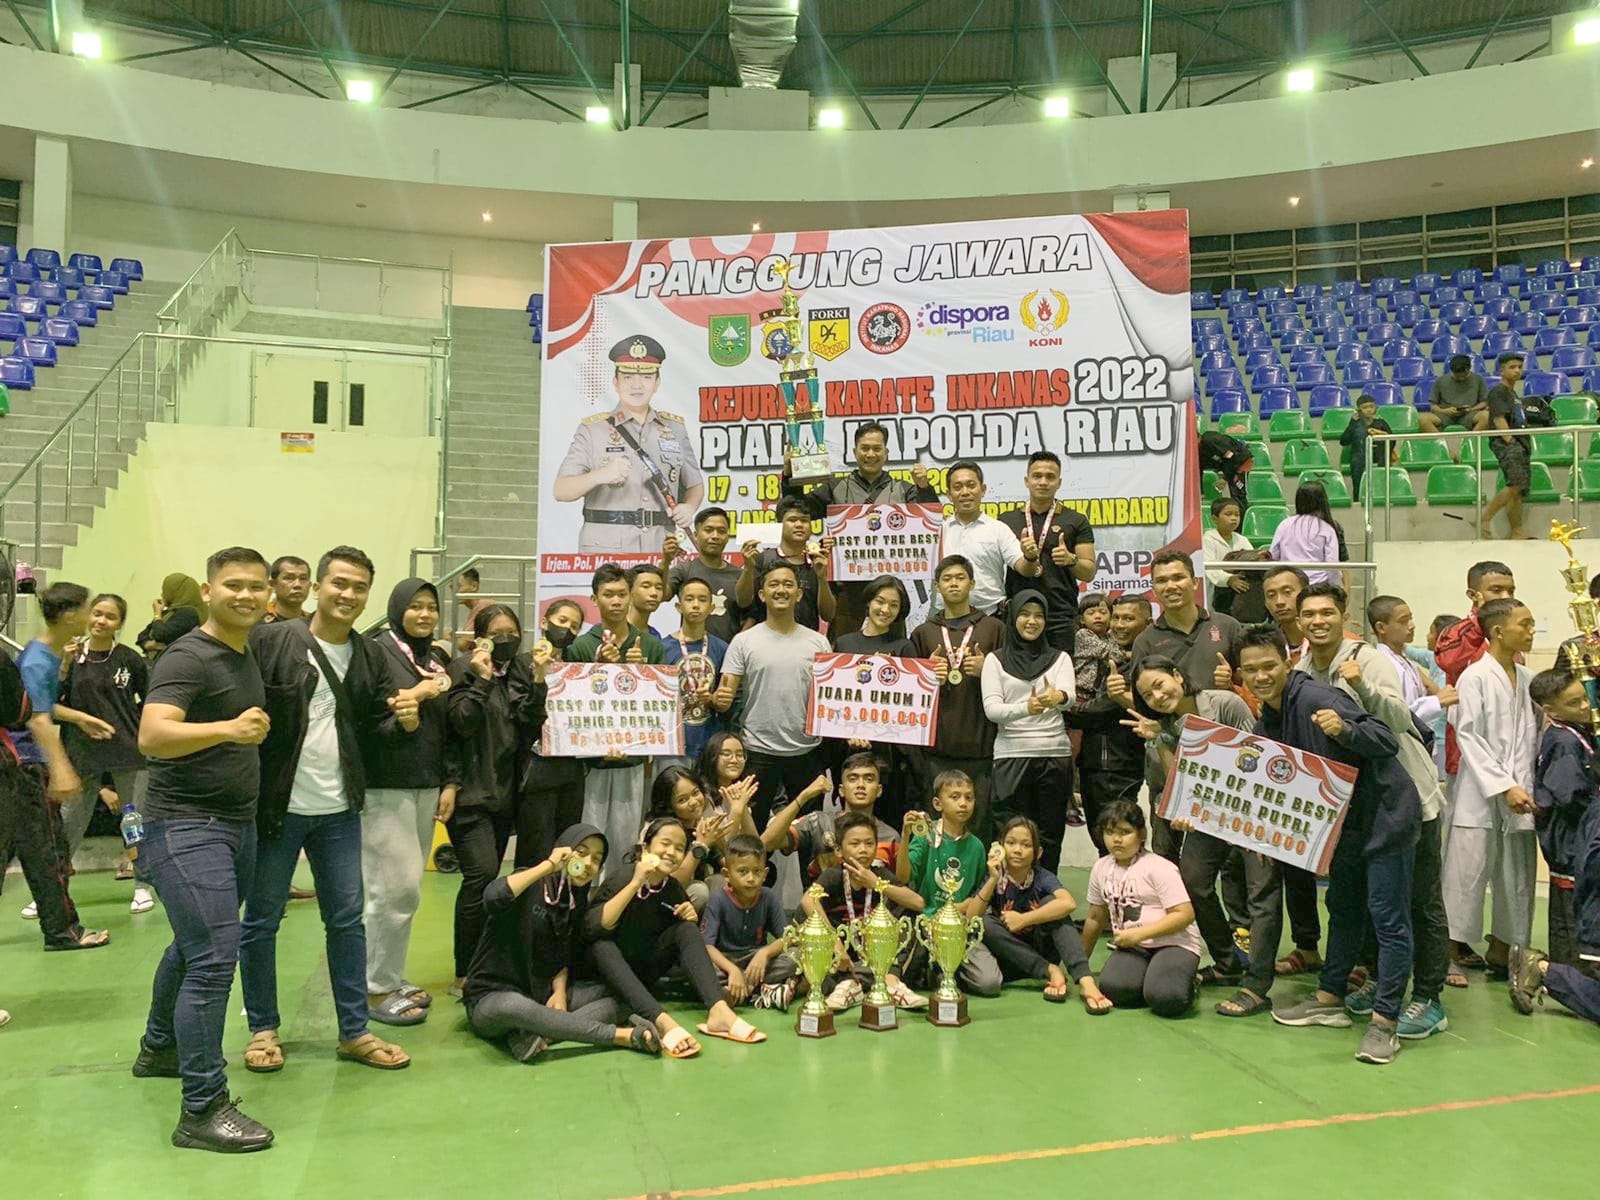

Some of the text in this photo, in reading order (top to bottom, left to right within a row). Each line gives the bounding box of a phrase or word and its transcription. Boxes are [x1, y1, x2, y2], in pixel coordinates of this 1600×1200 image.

[635, 233, 1092, 298] PANGGUNG JAWARA
[811, 309, 847, 320] FORKI
[929, 304, 1010, 329] dispora
[972, 326, 1014, 343] Riau
[1029, 338, 1062, 347] KONI
[825, 376, 934, 417] KARATE
[946, 368, 1071, 411] INKANAS
[1074, 355, 1170, 404] 2022
[1064, 404, 1174, 456] RIAU
[708, 475, 730, 503] 17
[756, 473, 780, 501] 18
[1061, 496, 1169, 527] KANBARU
[832, 534, 939, 547] BEST OF THE BEST
[546, 553, 571, 572] Irjen.
[573, 555, 592, 570] Pol.
[844, 547, 928, 560] SENIOR PUTRA
[1096, 551, 1153, 575] APP
[848, 561, 928, 575] Rp 1.000.000
[547, 699, 678, 713] BEST OF THE BEST
[818, 686, 932, 709] JUARA UMUM II
[567, 716, 614, 729] JUNIOR
[817, 704, 928, 728] Rp 3.000.000
[1177, 757, 1338, 825] BEST OF THE BEST
[1192, 782, 1312, 836] SENIOR PUTRI
[1190, 801, 1307, 857] Rp 1.000.000
